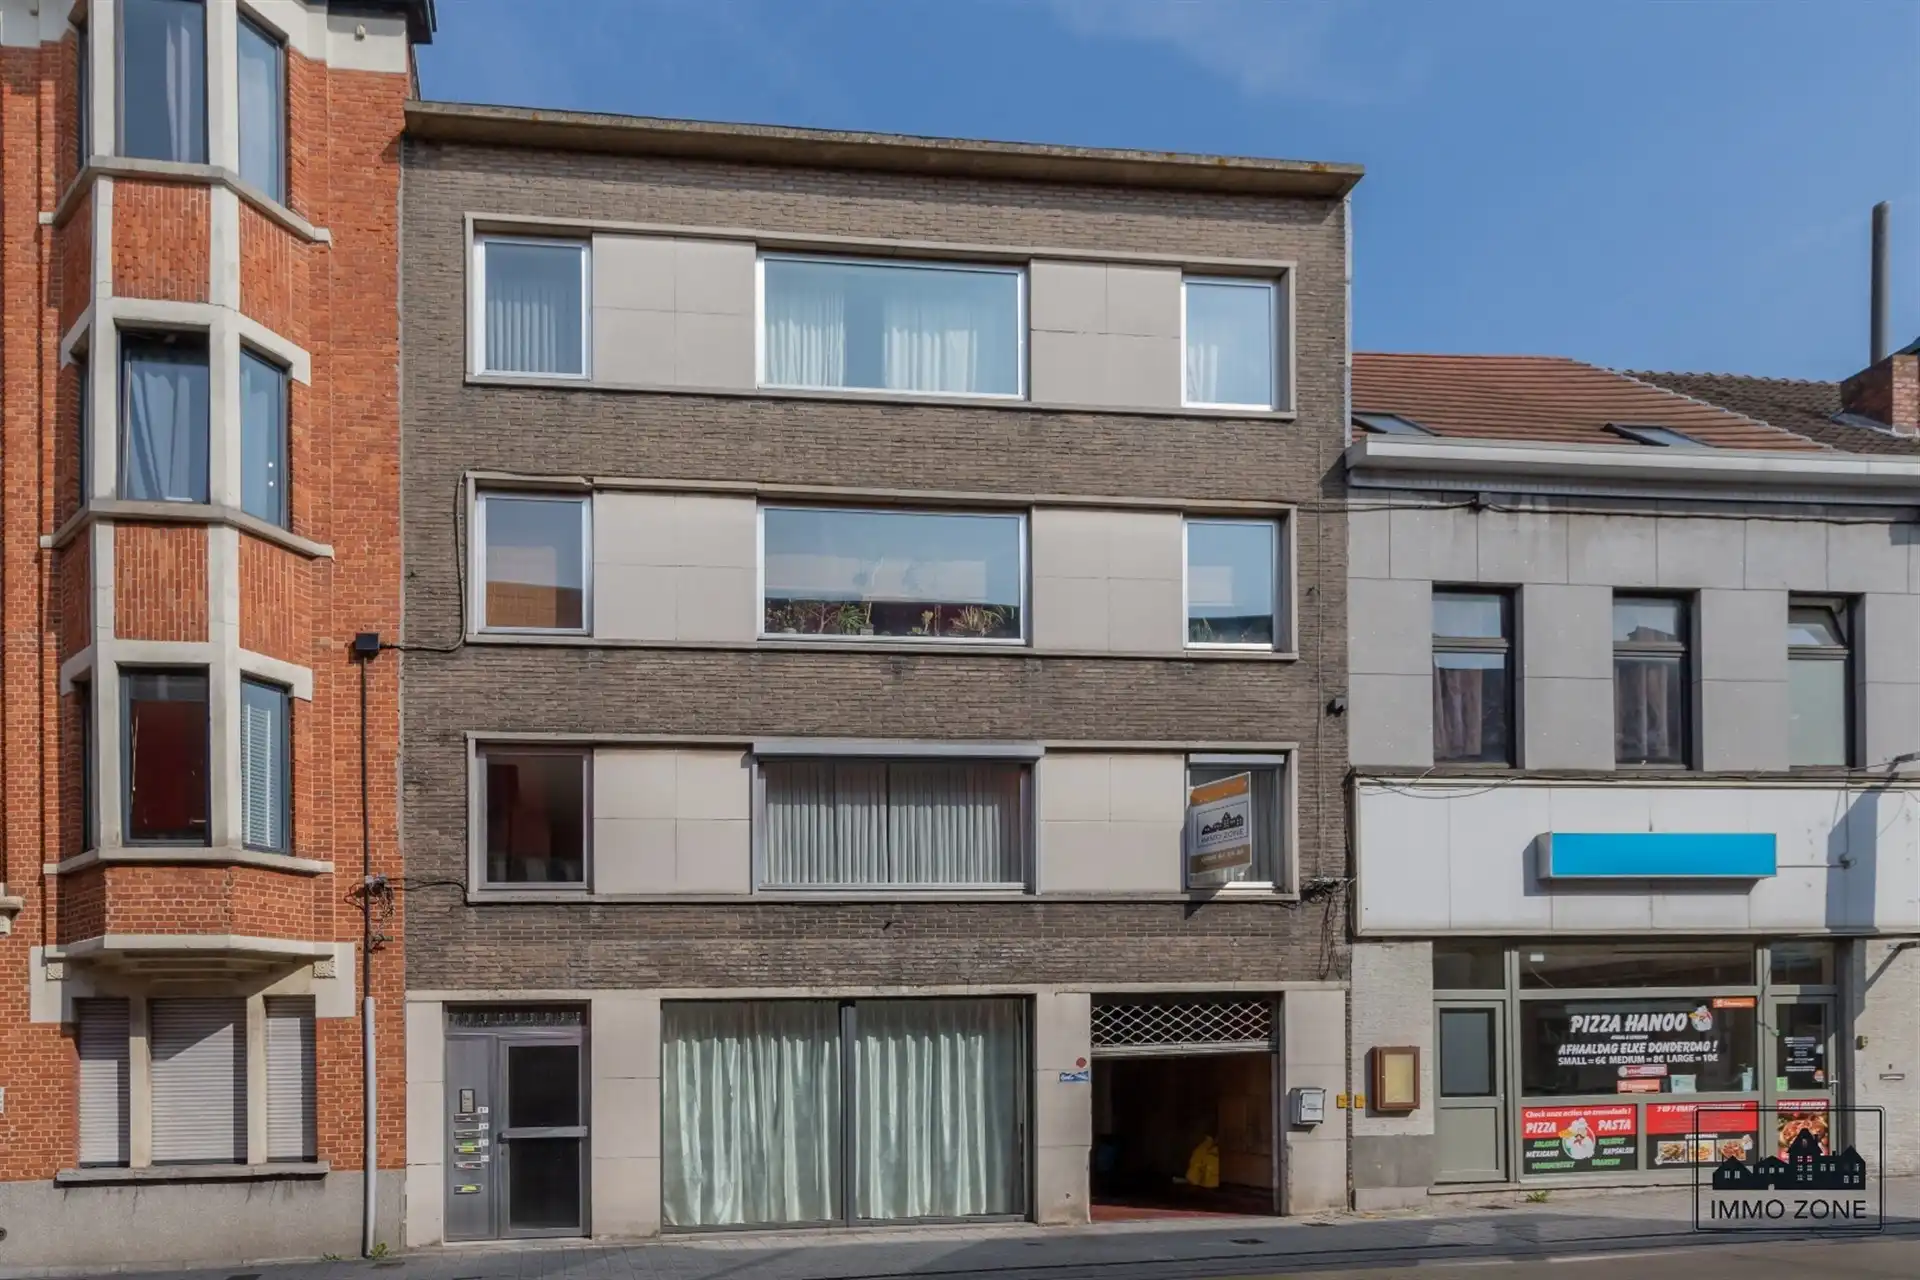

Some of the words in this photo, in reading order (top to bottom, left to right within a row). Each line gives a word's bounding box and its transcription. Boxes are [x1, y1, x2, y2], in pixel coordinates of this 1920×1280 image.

[1223, 828, 1245, 839] ZONE
[1570, 1014, 1621, 1033] PIZZA
[1625, 1012, 1688, 1032] HANOO
[1558, 1043, 1619, 1056] AFHAALDAG
[1620, 1042, 1647, 1054] ELKE
[1648, 1041, 1711, 1053] DONDERDAG
[1558, 1056, 1587, 1066] SMALL
[1595, 1056, 1606, 1065] 6€
[1609, 1055, 1645, 1064] MEDIUM
[1667, 1054, 1694, 1063] LARGE
[1702, 1054, 1719, 1062] 10€
[1525, 1109, 1545, 1118] Check
[1525, 1121, 1557, 1134] PIZZA
[1598, 1119, 1632, 1131] PASTA
